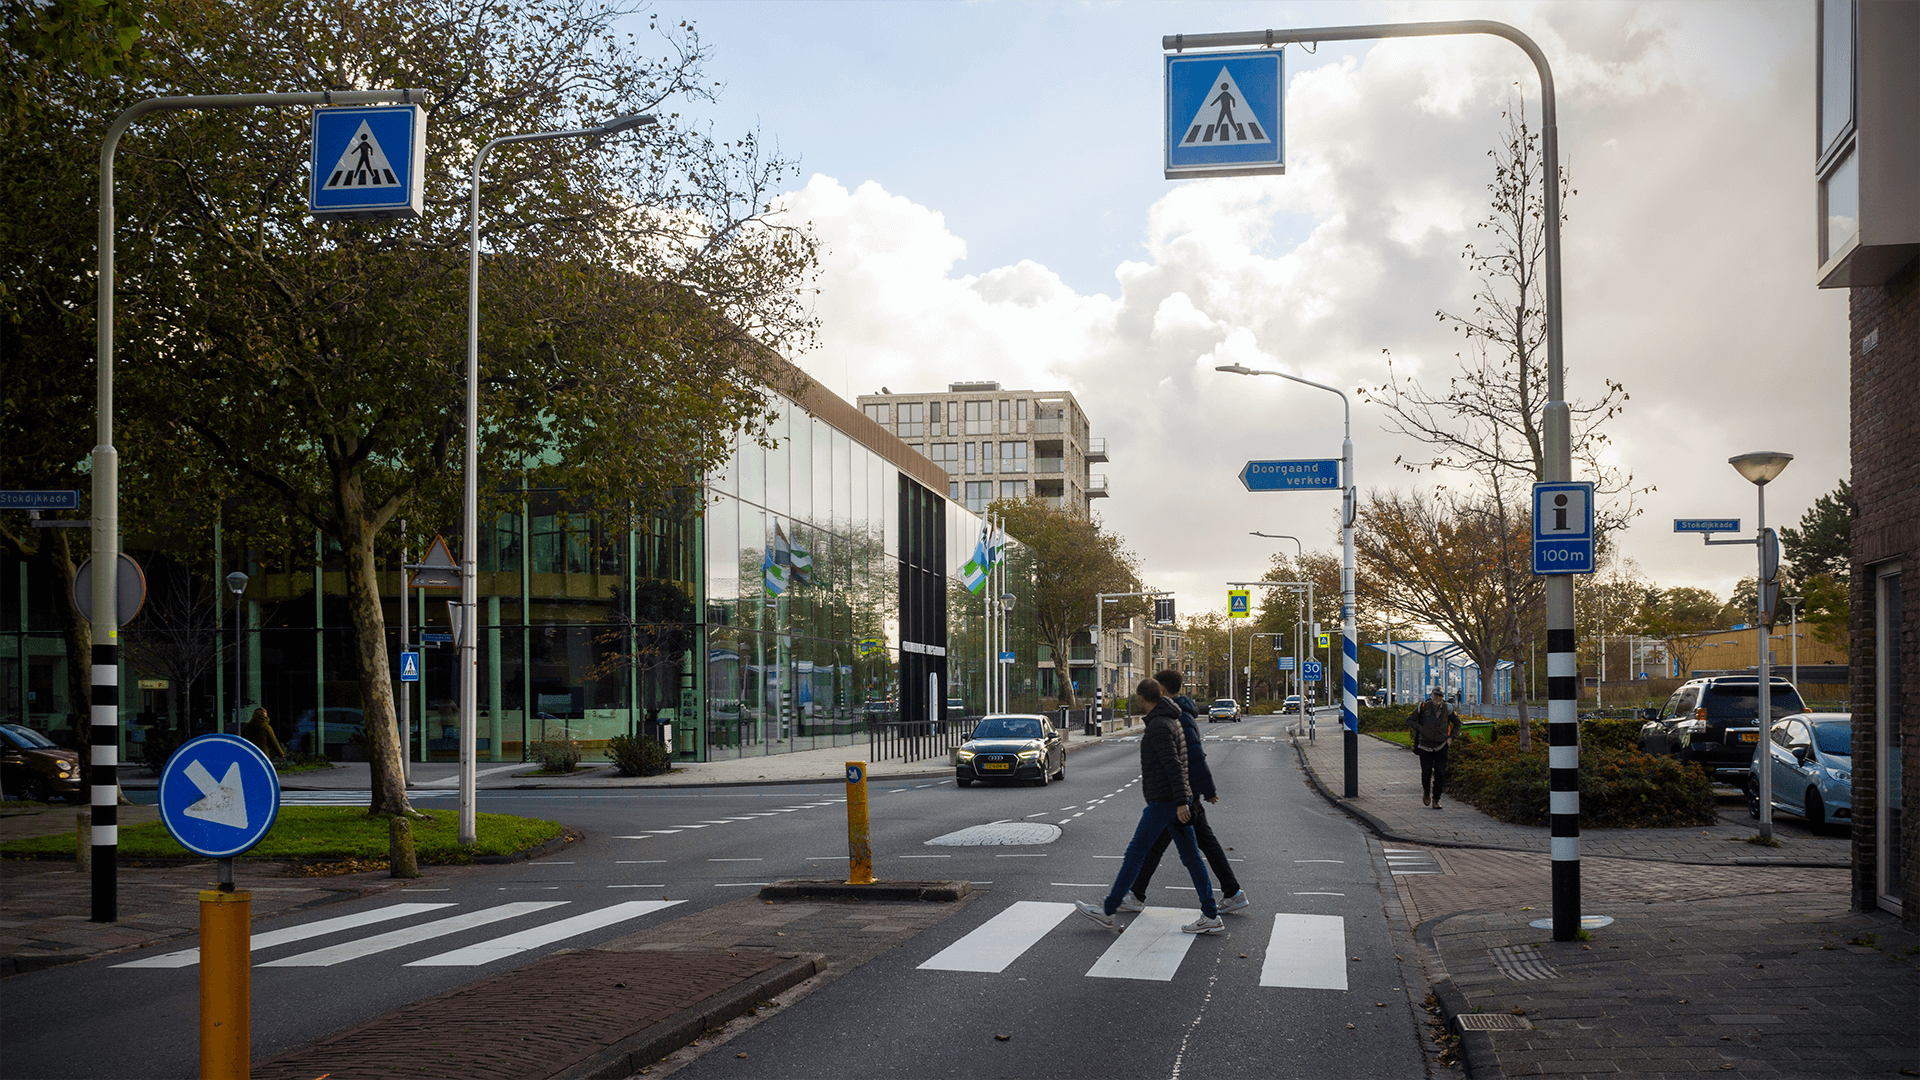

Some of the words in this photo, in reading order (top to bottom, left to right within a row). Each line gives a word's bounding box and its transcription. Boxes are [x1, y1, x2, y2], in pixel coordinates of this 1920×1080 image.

[1252, 463, 1319, 476] Doorgaand
[1286, 475, 1334, 485] verkeer
[0, 493, 68, 505] Stokdijkkade
[1681, 521, 1734, 530] Stokdijkkade
[1541, 549, 1584, 562] 100m
[1304, 663, 1320, 674] 30
